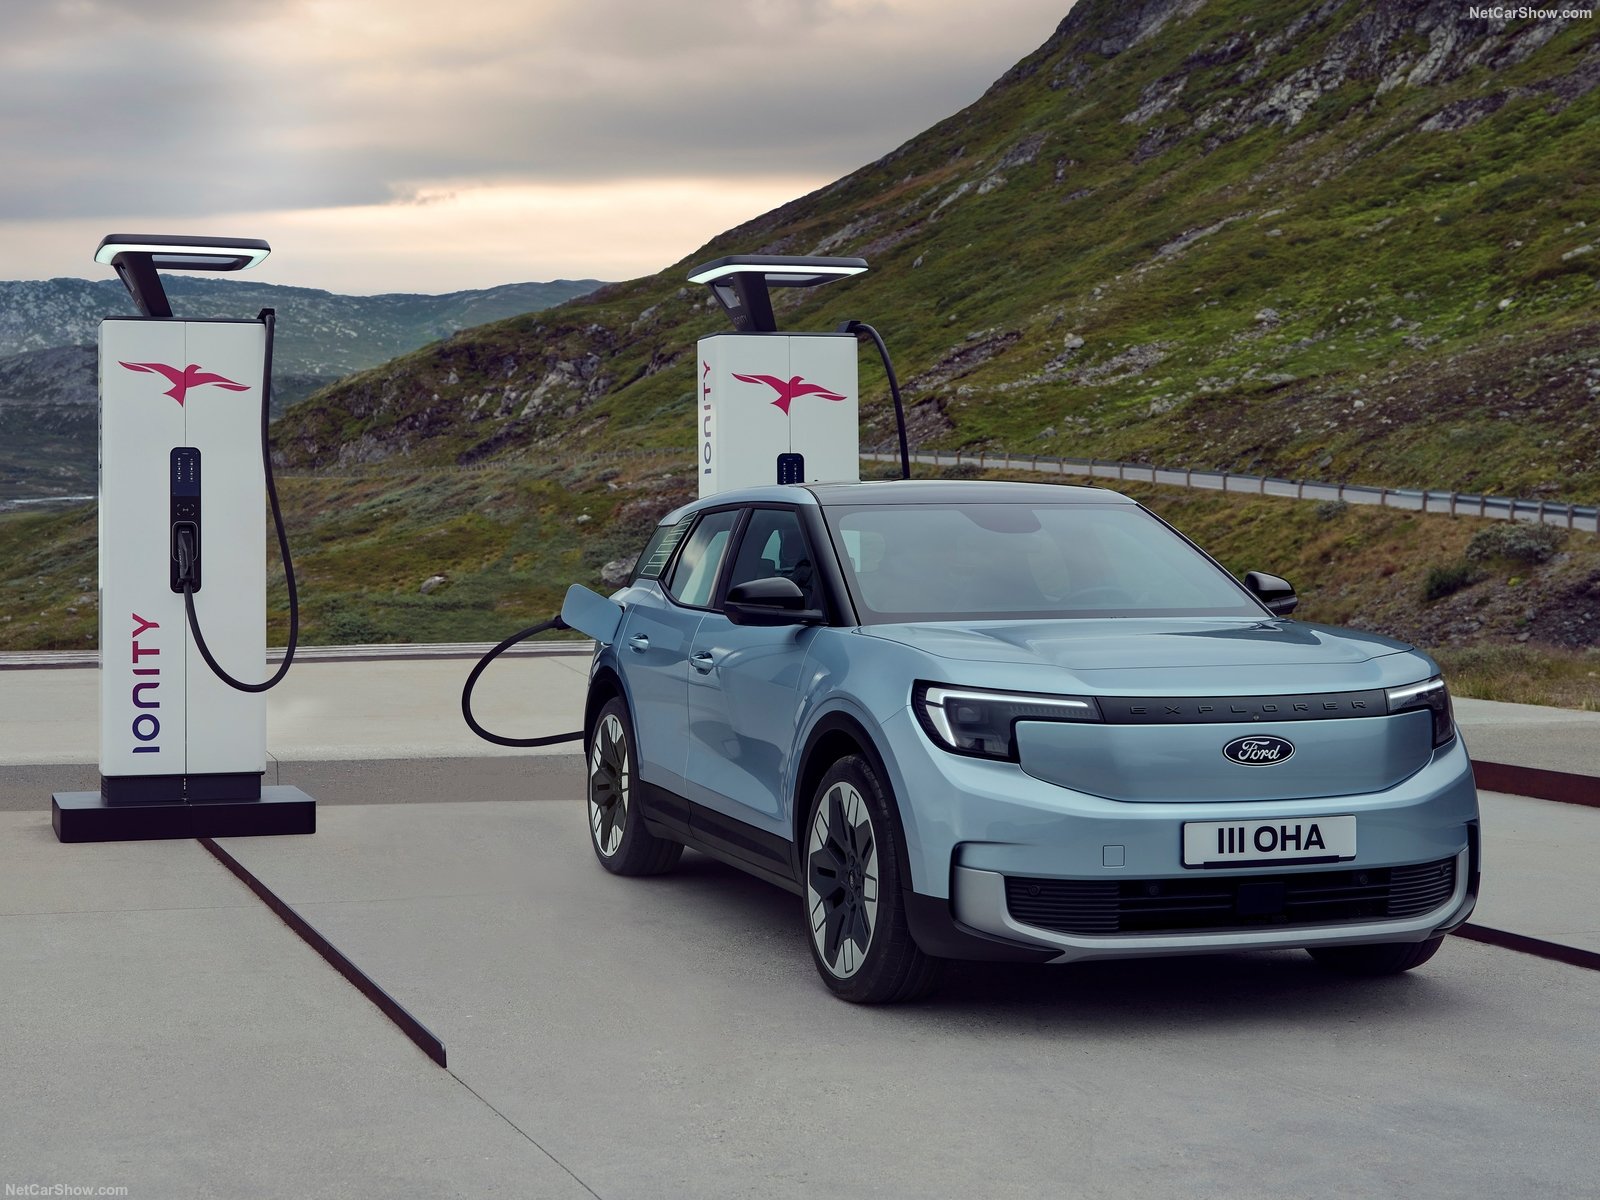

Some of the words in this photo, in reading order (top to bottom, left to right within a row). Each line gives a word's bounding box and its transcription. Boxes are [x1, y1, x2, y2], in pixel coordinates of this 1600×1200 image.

[703, 360, 712, 475] IONITY
[132, 613, 160, 754] IONITY
[1129, 699, 1367, 716] EXPLORER
[1238, 740, 1281, 760] Ford
[1253, 824, 1326, 853] OHA
